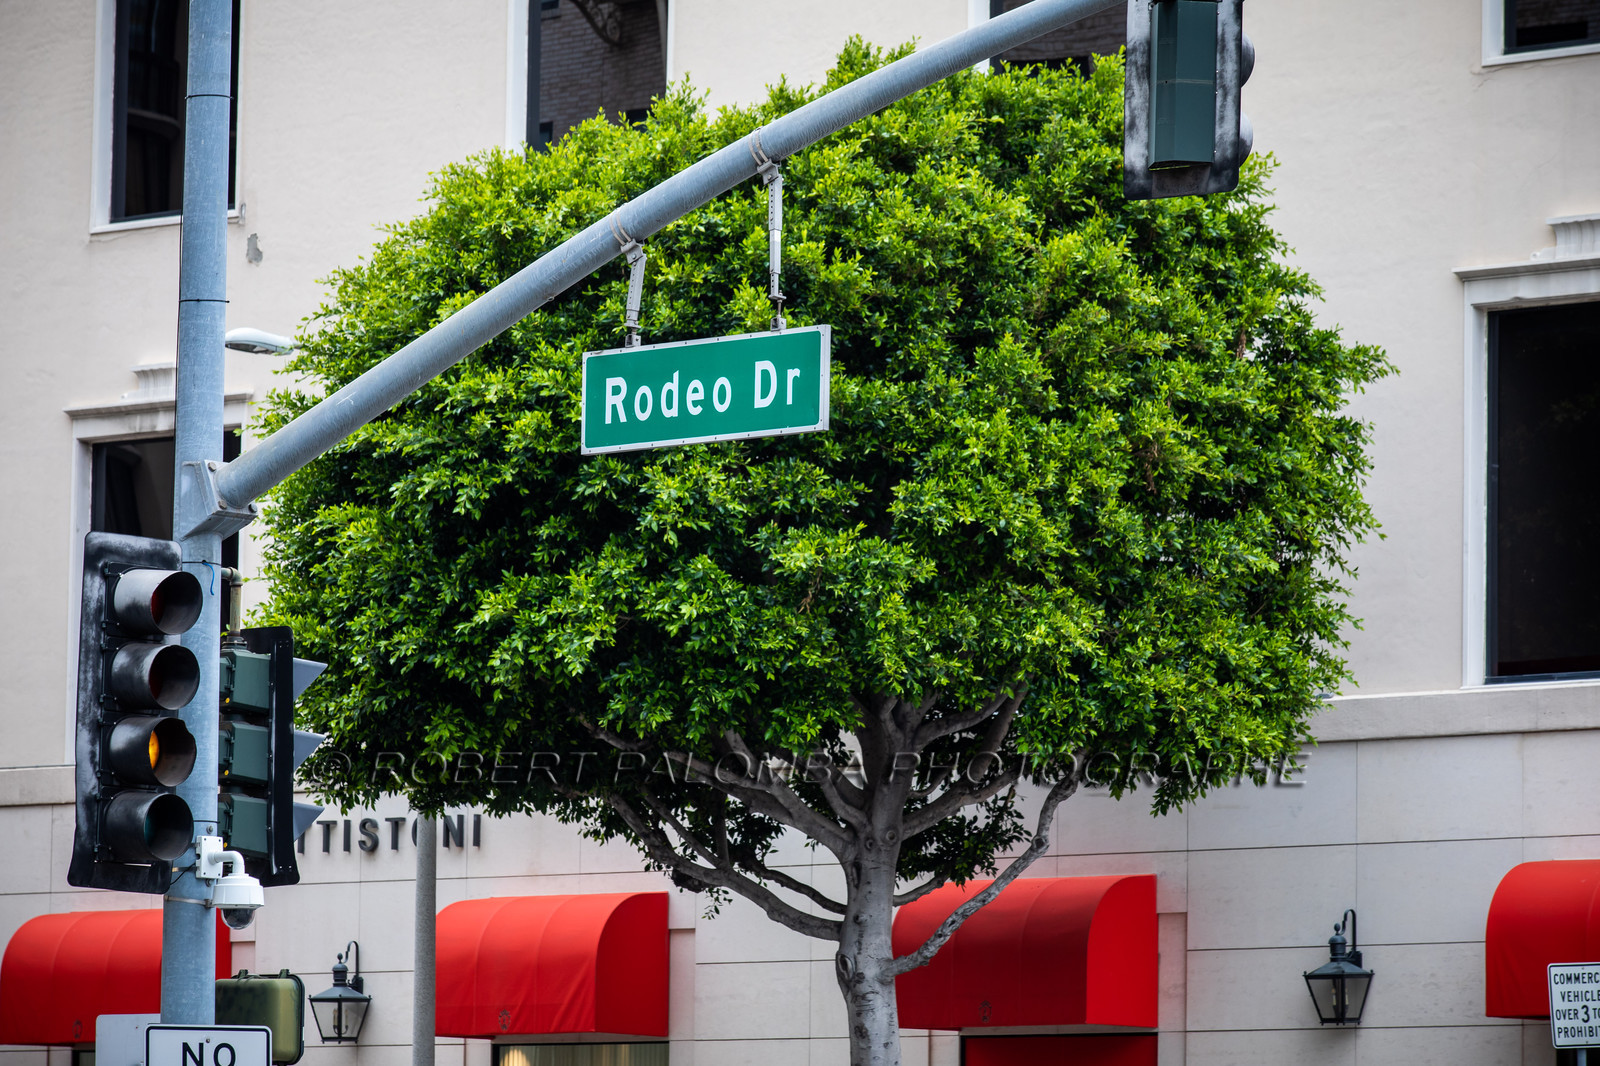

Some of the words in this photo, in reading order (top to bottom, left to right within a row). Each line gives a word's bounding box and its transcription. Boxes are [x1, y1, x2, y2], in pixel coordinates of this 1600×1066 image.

[604, 370, 732, 425] Rodeo
[753, 360, 801, 409] Dr
[1555, 1008, 1579, 1020] OVER
[1581, 1004, 1590, 1023] 3
[182, 1042, 236, 1066] NO
